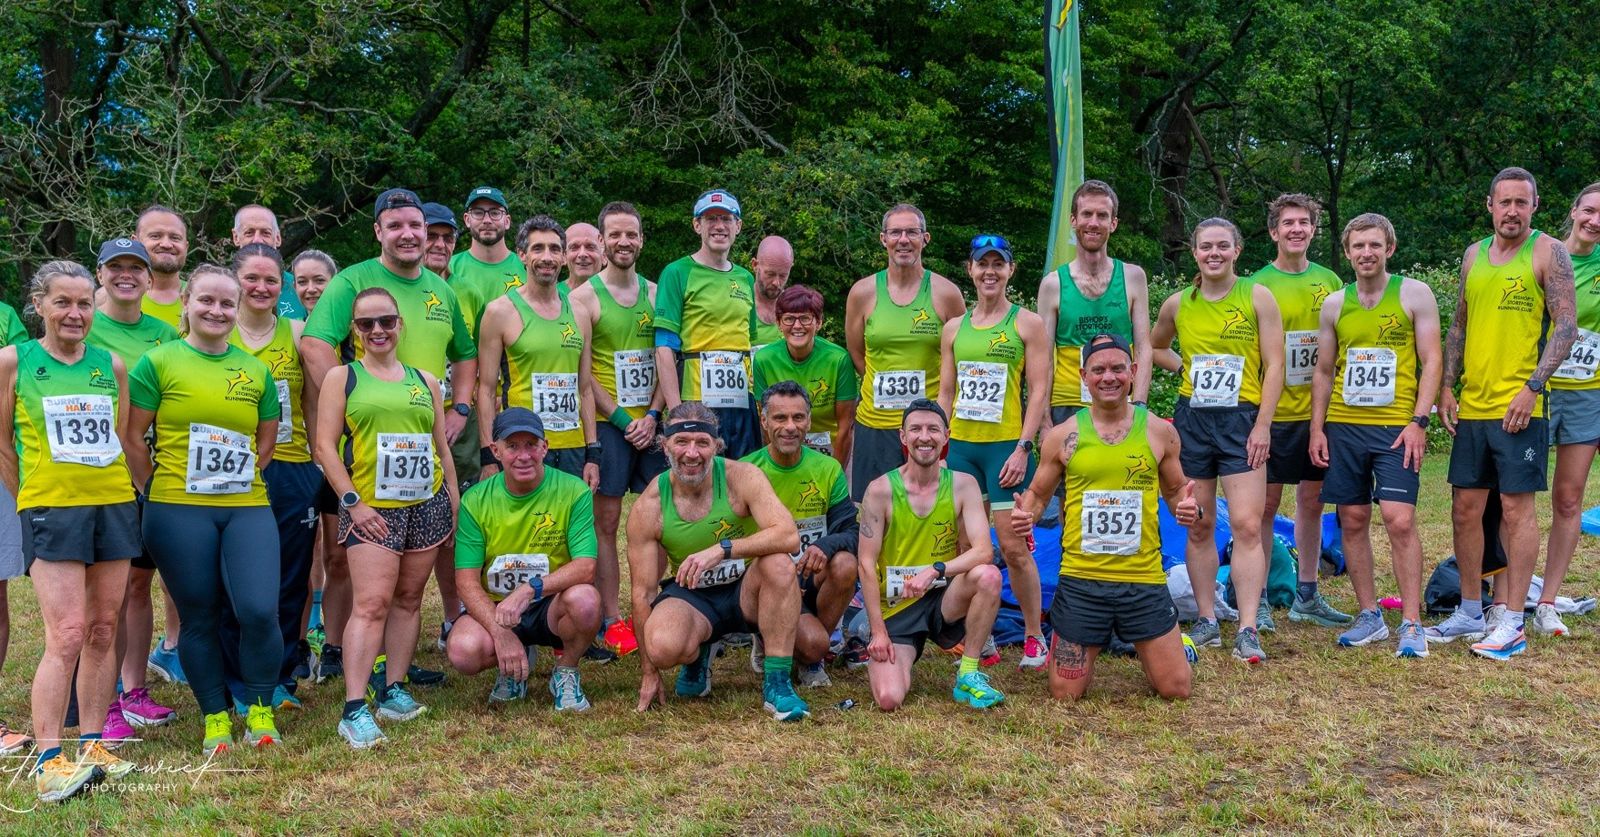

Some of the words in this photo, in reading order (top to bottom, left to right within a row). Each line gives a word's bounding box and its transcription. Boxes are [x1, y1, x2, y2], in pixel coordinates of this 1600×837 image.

[1291, 348, 1318, 368] 136
[1566, 346, 1595, 365] 46
[621, 366, 654, 389] 1357
[706, 368, 745, 390] 1386
[878, 375, 920, 396] 1330
[1193, 370, 1236, 392] 1374
[1347, 366, 1391, 387] 1345
[539, 392, 577, 413] 1340
[960, 380, 1000, 403] 1332
[55, 418, 111, 446] 1339
[195, 446, 250, 475] 1367
[383, 454, 431, 480] 1378
[1087, 511, 1137, 535] 1352
[494, 572, 541, 591] 135
[700, 563, 740, 586] 344
